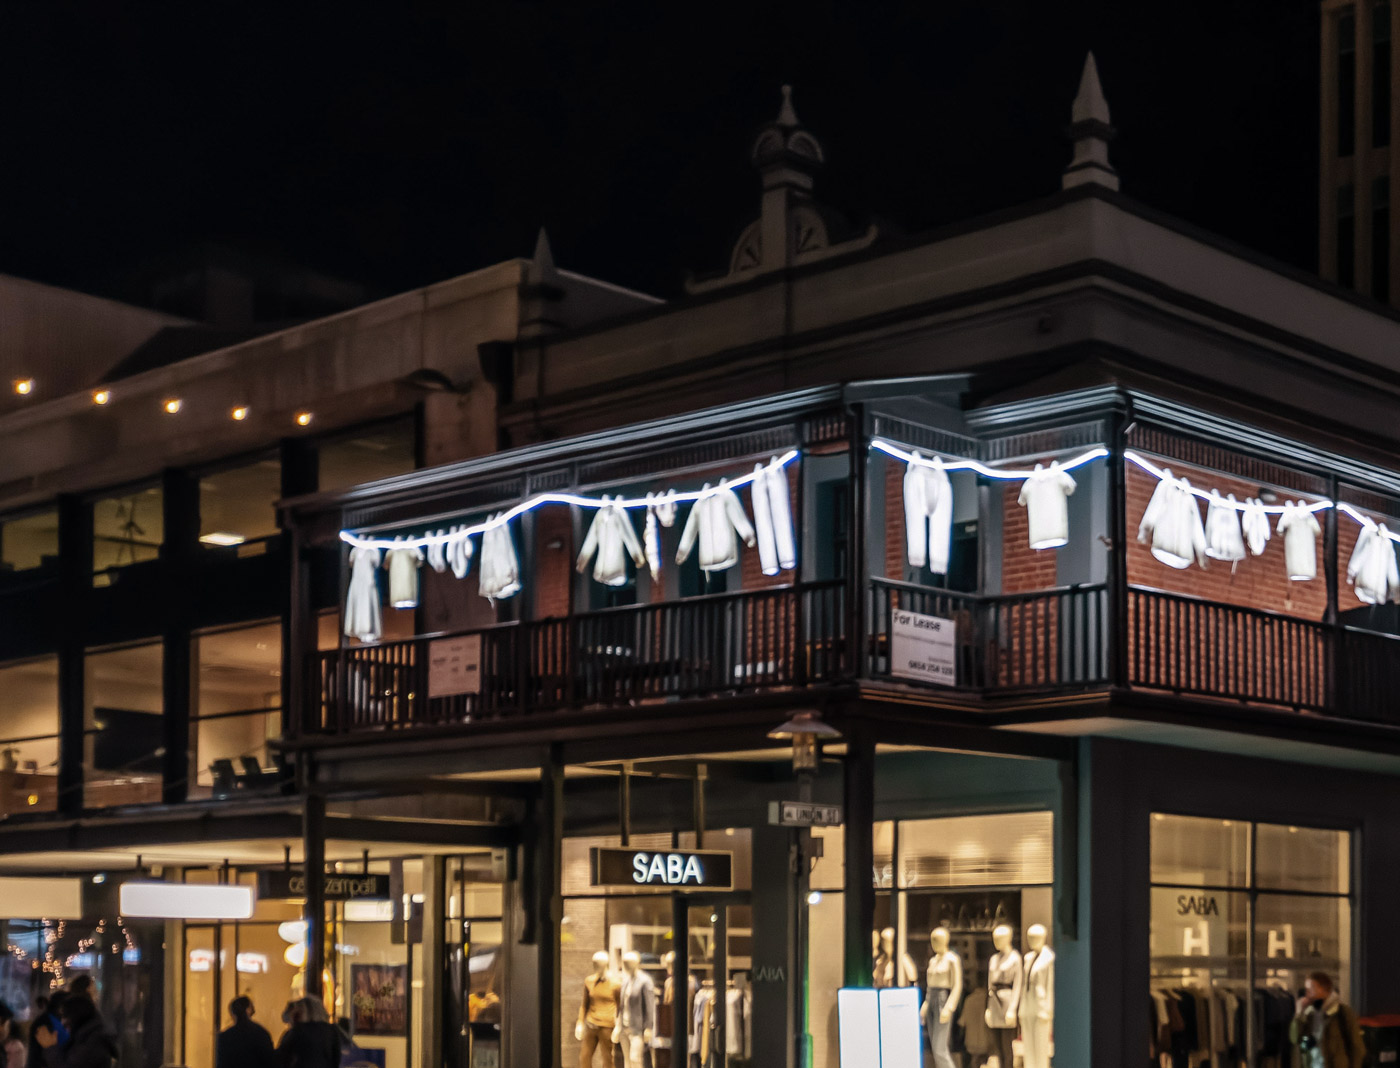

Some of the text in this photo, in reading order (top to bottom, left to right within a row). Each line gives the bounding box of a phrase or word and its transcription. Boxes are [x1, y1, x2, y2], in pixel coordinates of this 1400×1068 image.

[894, 612, 941, 632] For Lease
[632, 851, 704, 884] SABA
[1176, 894, 1219, 916] SABA
